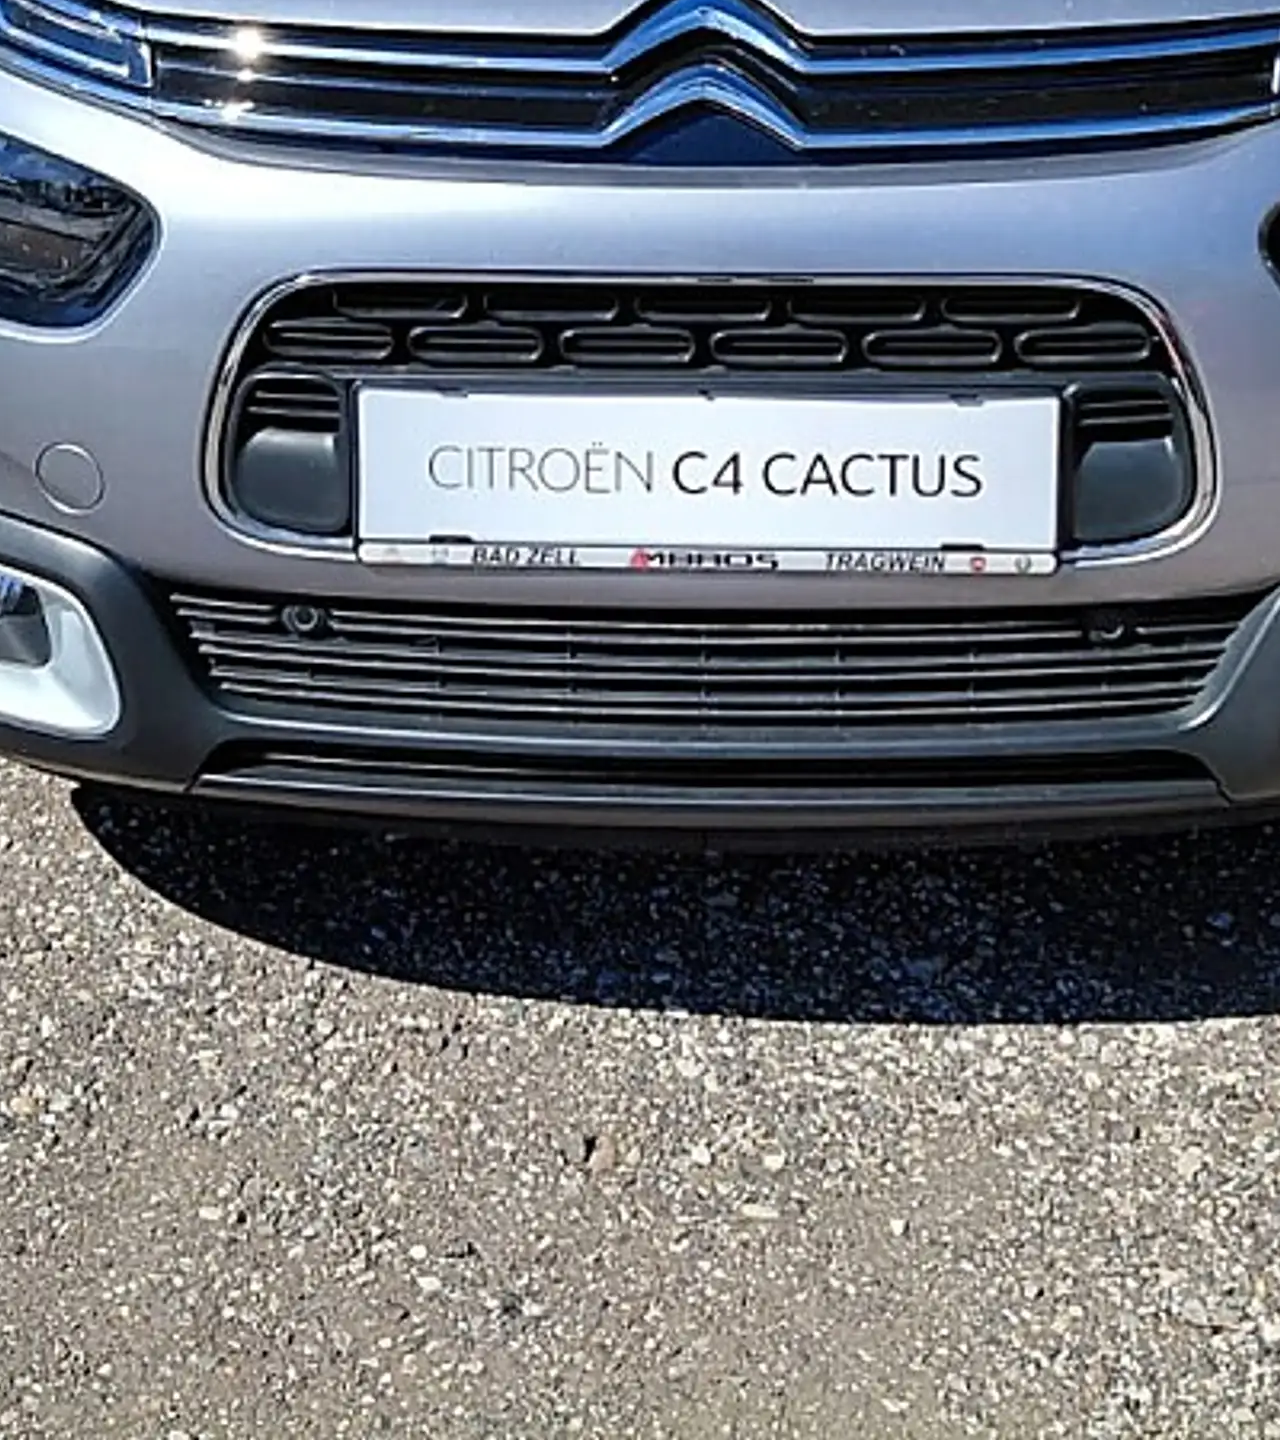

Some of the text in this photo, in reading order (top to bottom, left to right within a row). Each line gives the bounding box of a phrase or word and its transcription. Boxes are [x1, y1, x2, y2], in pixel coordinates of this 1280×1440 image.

[428, 441, 983, 498] CITROËN C4 CACTUS
[472, 546, 520, 565] BAD
[525, 547, 579, 566] ZELL
[824, 551, 947, 573] TRAGWEIN
